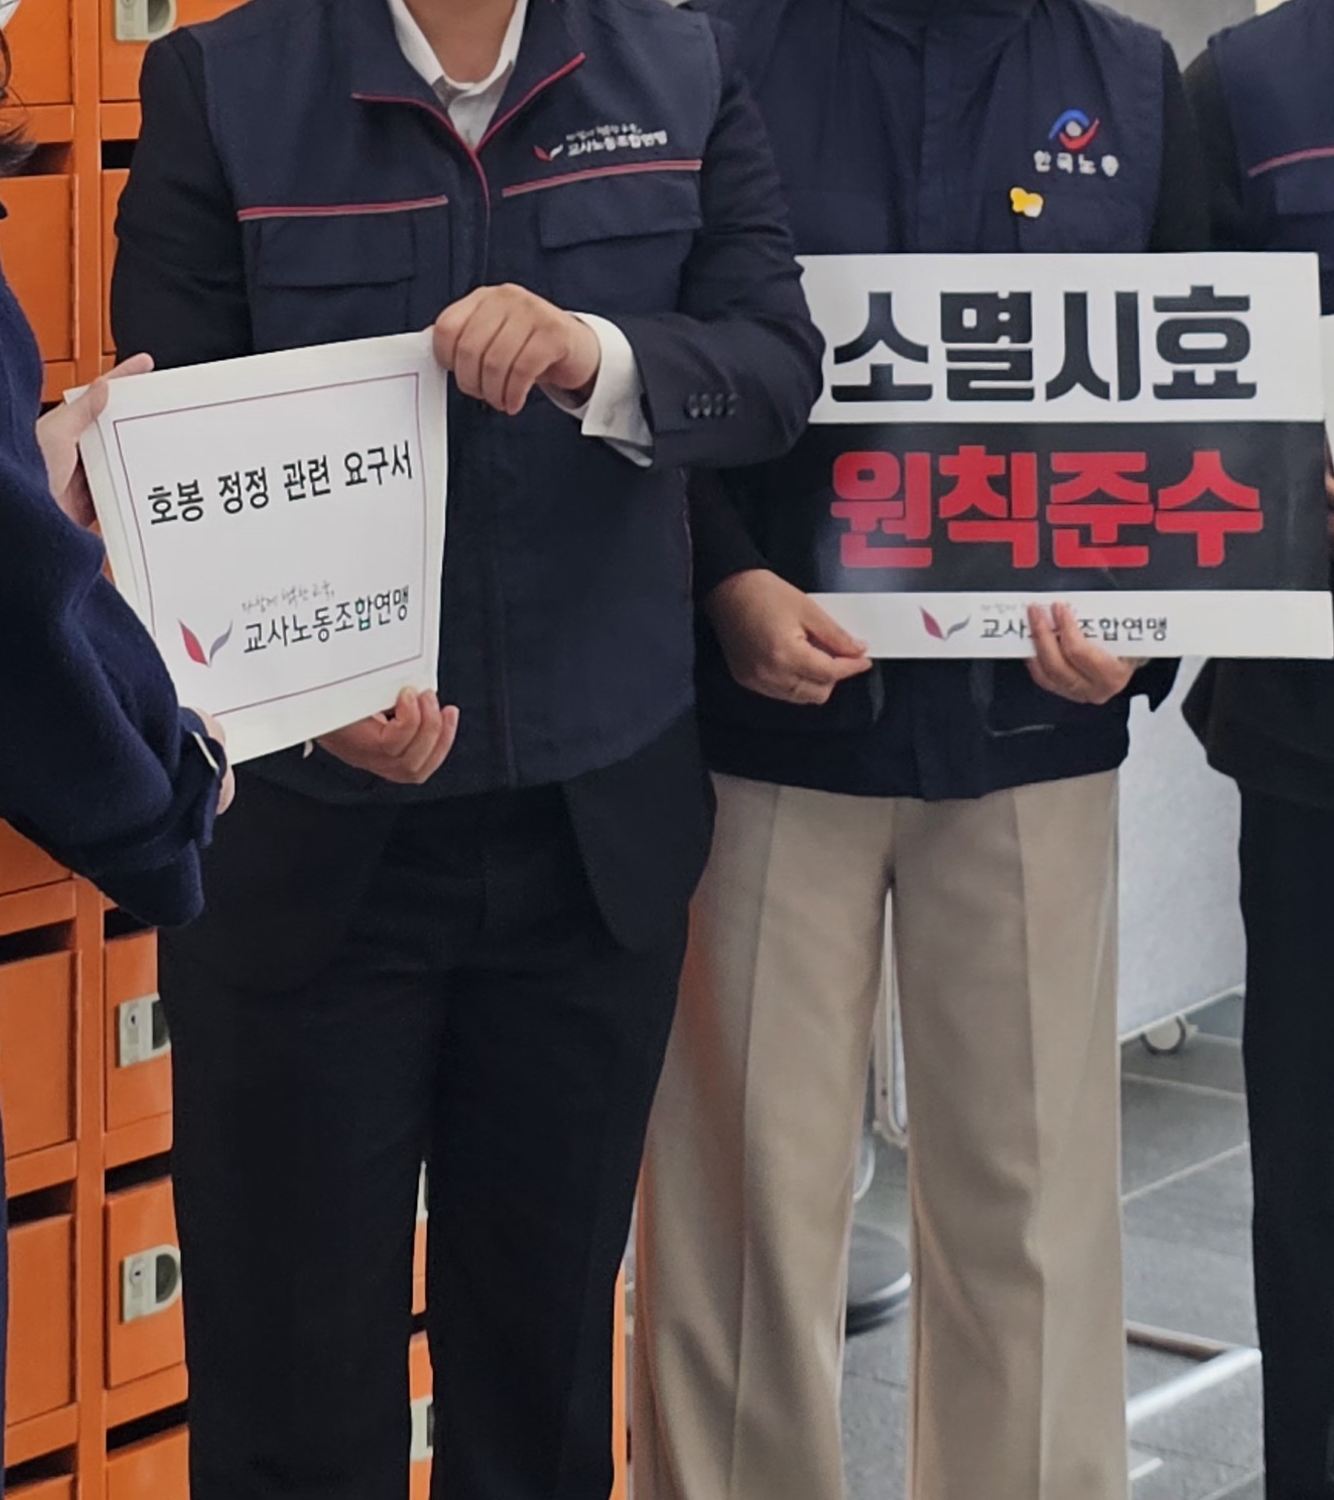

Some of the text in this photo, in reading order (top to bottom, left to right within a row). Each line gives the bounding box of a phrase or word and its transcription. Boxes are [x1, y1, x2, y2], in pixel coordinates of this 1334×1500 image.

[1033, 150, 1120, 177] 한국노총
[830, 285, 1258, 402] 소멸시효
[147, 440, 414, 525] 호봉 정정 관련 요구서
[830, 445, 1264, 569] 원칙준수
[243, 585, 410, 653] 교사노동조합연맹
[980, 616, 1169, 643] 교사조합연맹
